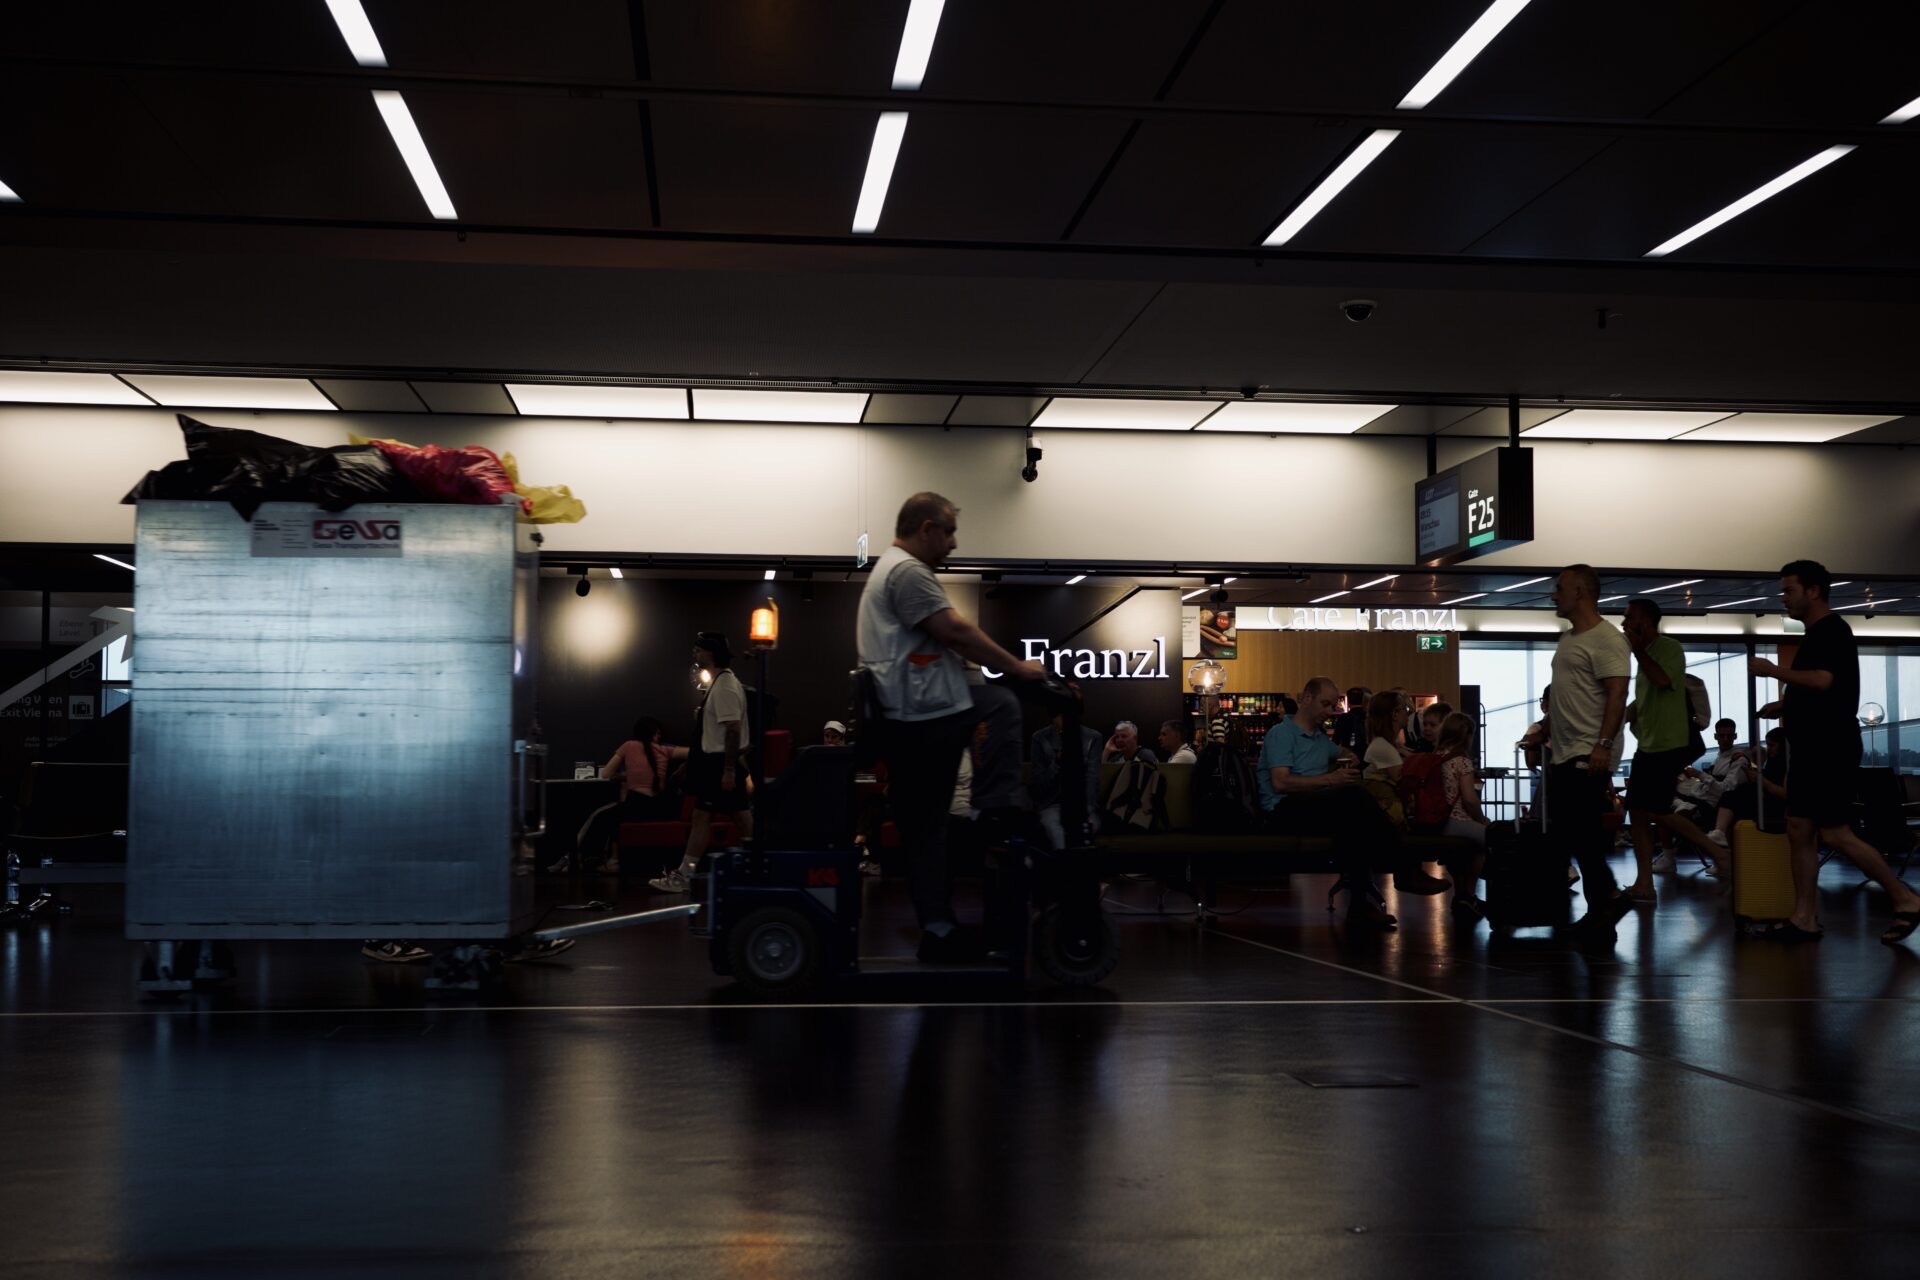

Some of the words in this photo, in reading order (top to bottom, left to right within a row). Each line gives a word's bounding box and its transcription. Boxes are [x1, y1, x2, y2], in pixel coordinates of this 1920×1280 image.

[1468, 489, 1479, 500] Gate
[1020, 636, 1169, 679] Franzl
[23, 707, 63, 718] Viena
